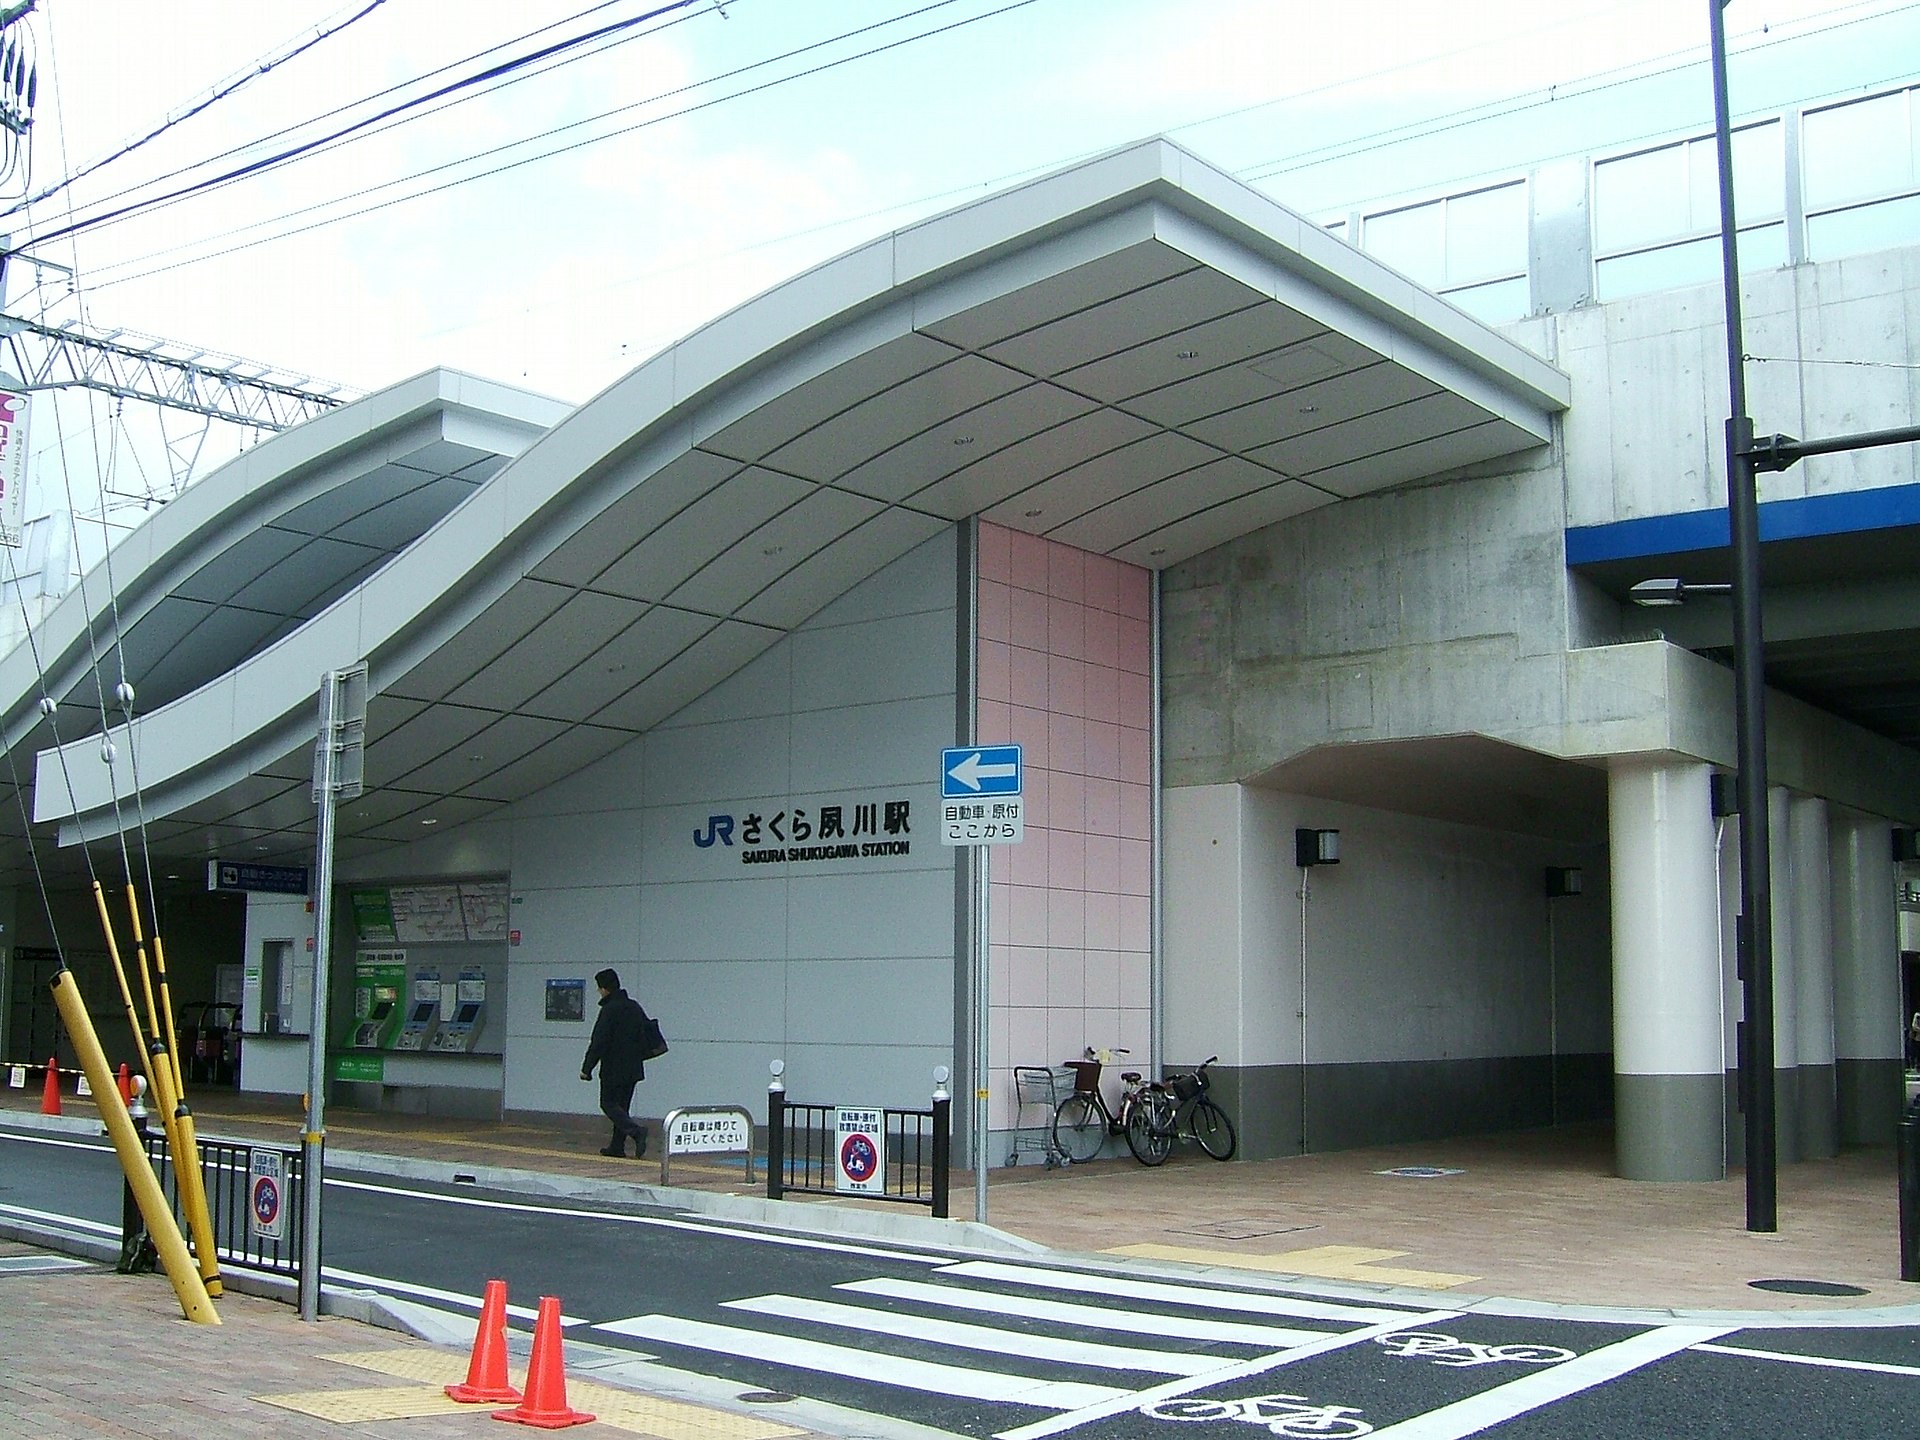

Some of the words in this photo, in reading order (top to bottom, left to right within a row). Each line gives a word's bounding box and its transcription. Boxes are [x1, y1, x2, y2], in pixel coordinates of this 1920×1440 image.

[693, 814, 735, 848] JR
[742, 801, 911, 844] さくら夙川駅
[949, 823, 1015, 839] ここから
[742, 849, 787, 864] SAKURA
[788, 844, 859, 862] SHUKUGAWA
[861, 841, 910, 857] STATION
[681, 1120, 737, 1133] 自転車は降りて
[674, 1134, 742, 1145] 通行してください
